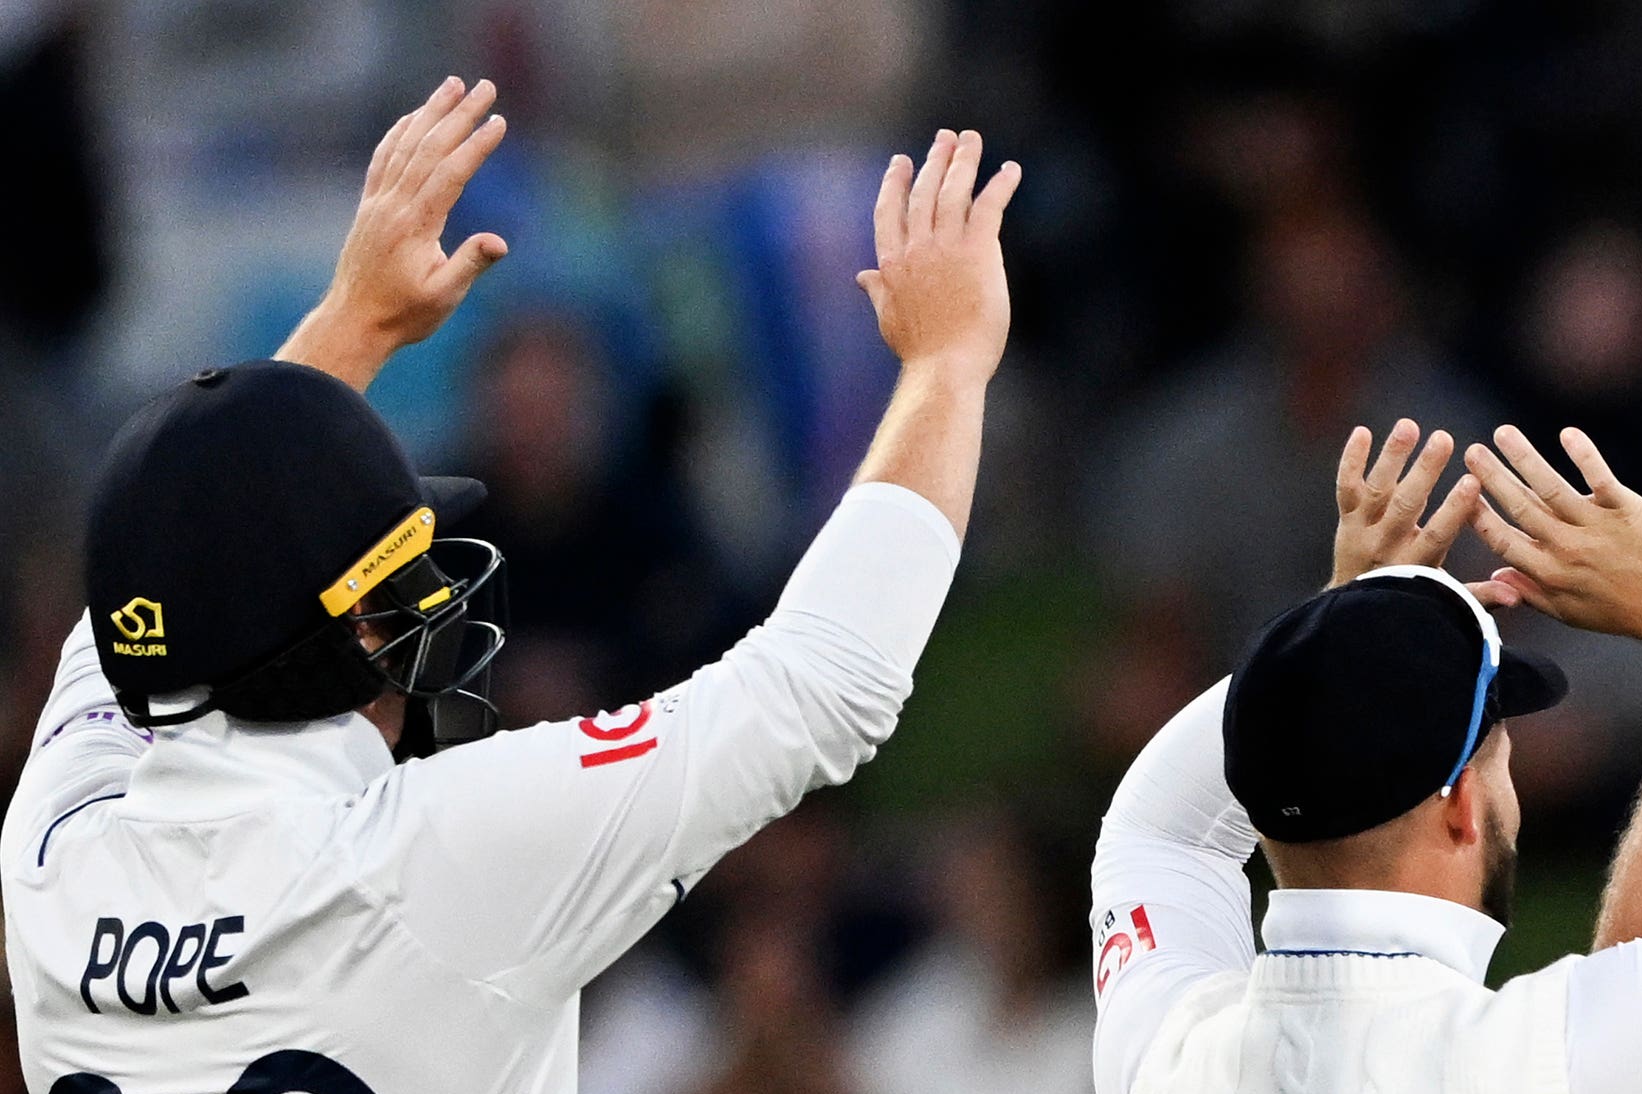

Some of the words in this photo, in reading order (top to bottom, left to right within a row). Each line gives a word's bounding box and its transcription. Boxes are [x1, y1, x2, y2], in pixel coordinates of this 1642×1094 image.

[361, 526, 417, 577] MASURI
[113, 641, 168, 656] MASURI
[81, 915, 250, 1017] POPE
